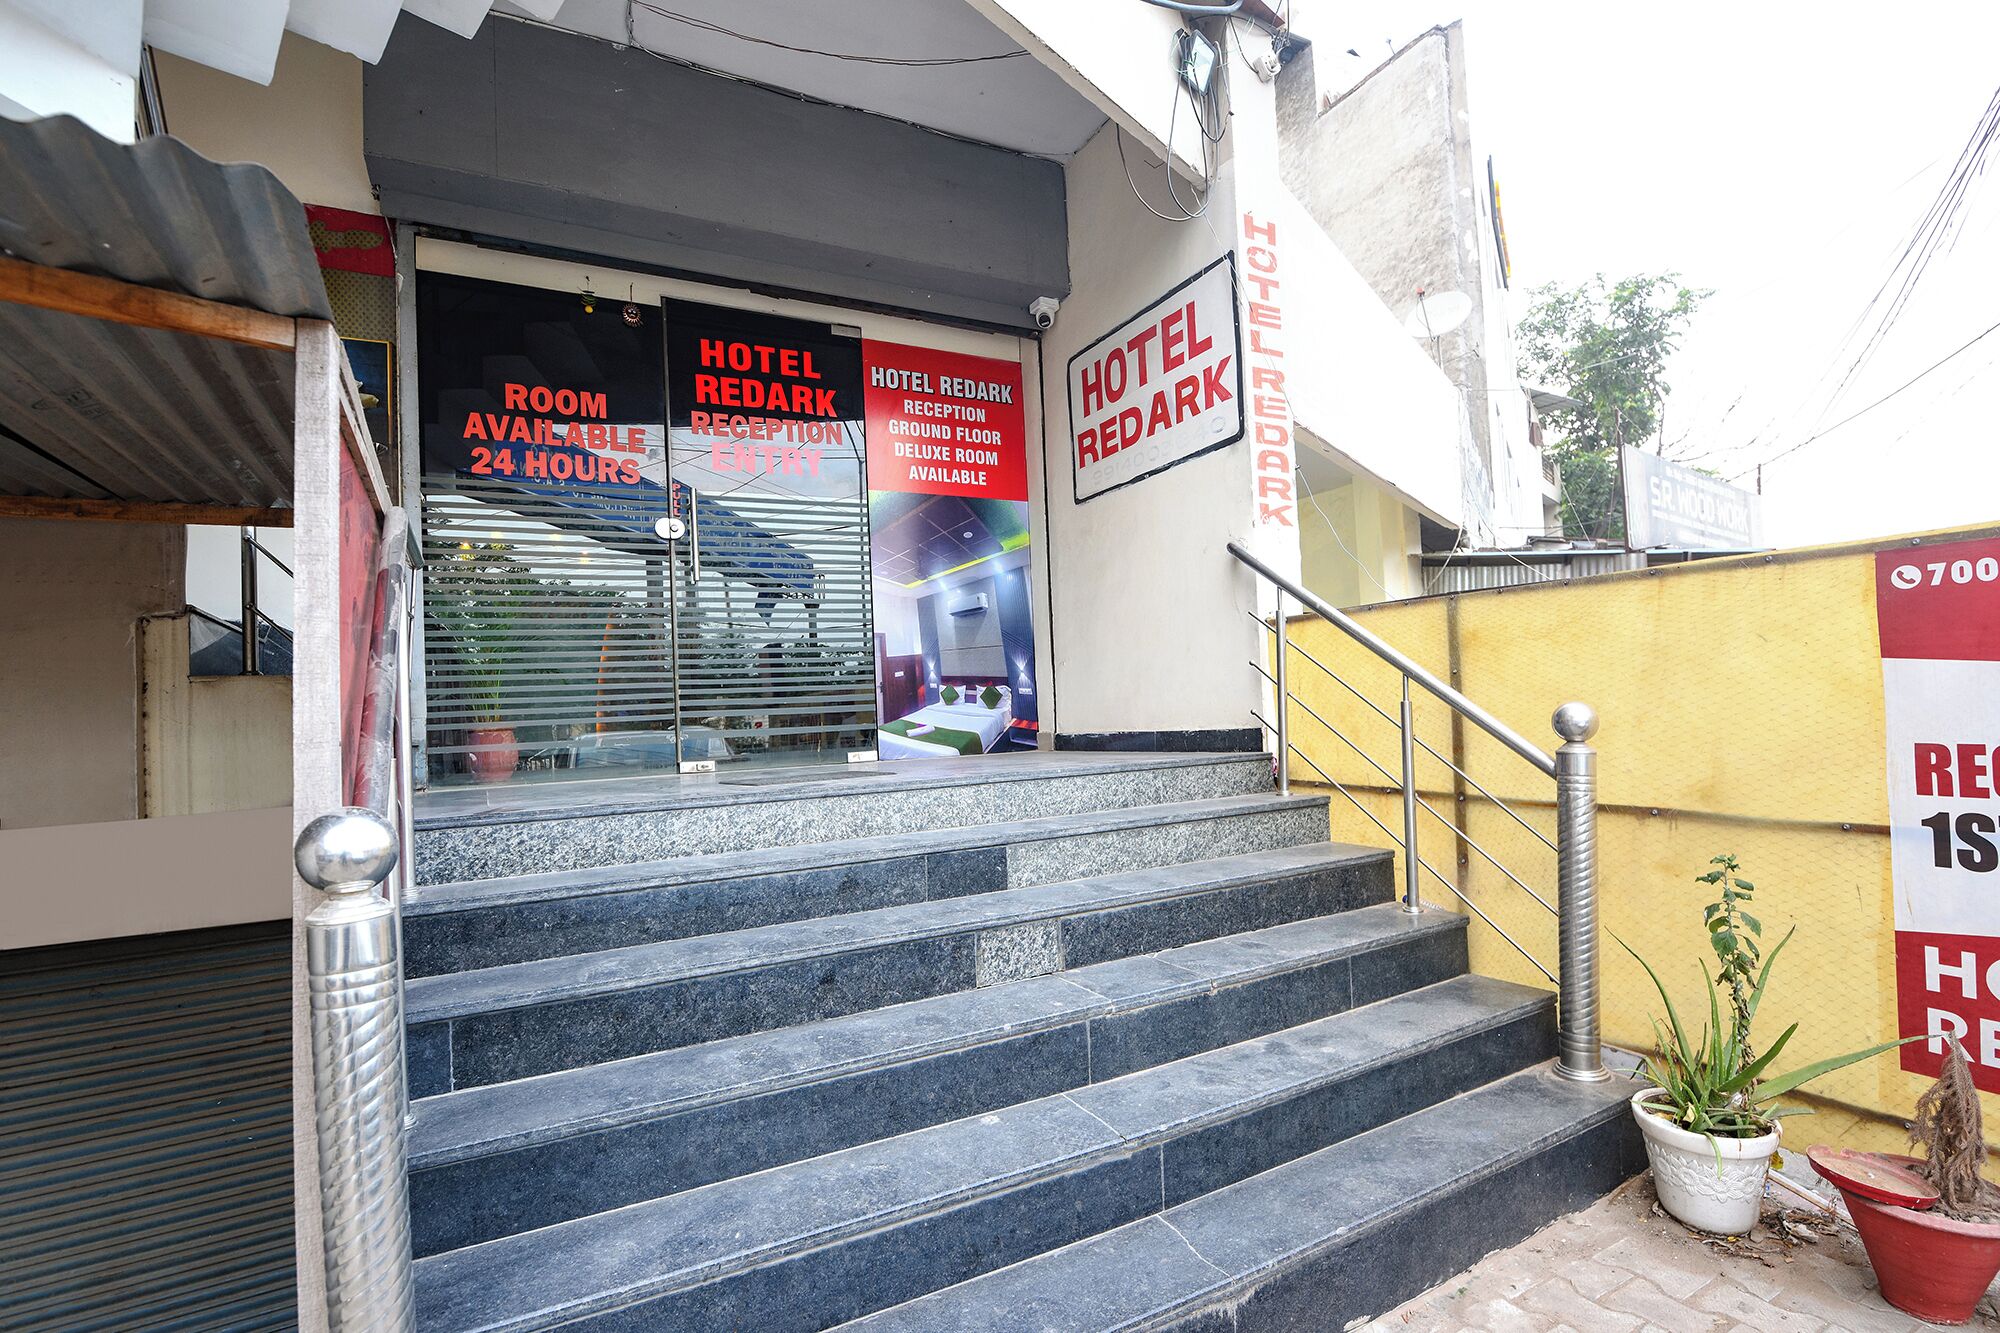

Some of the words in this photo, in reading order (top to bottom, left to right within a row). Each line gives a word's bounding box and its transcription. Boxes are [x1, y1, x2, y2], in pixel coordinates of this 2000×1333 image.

[1243, 213, 1283, 358] HOTEL
[700, 338, 822, 380] HOTEL
[1081, 300, 1213, 418] HOTEL
[504, 382, 608, 419] ROOM
[694, 373, 838, 418] REDARK
[871, 366, 935, 395] HOTEL
[940, 375, 1013, 405] REDARK
[691, 410, 843, 446] RECEPTION
[903, 399, 986, 423] RECEPTION
[1077, 353, 1234, 469] REDARK
[463, 411, 647, 454] AVAILABLE
[888, 419, 951, 440] GROUND
[956, 426, 1002, 445] FLOOR
[1252, 366, 1294, 527] REDARK
[470, 446, 515, 476] 24
[525, 450, 641, 485] HOURS
[710, 441, 824, 477] ENTRY
[894, 441, 951, 461] DELUXE
[955, 447, 998, 466] ROOM
[908, 465, 987, 485] AVAILABLE
[672, 482, 682, 518] PULL
[1676, 483, 1716, 524] WOOD
[1717, 497, 1750, 538] WORK
[1926, 557, 1999, 587] 700
[1914, 743, 2000, 799] RE
[1921, 811, 2000, 873] 1S
[1924, 945, 2000, 1001] H
